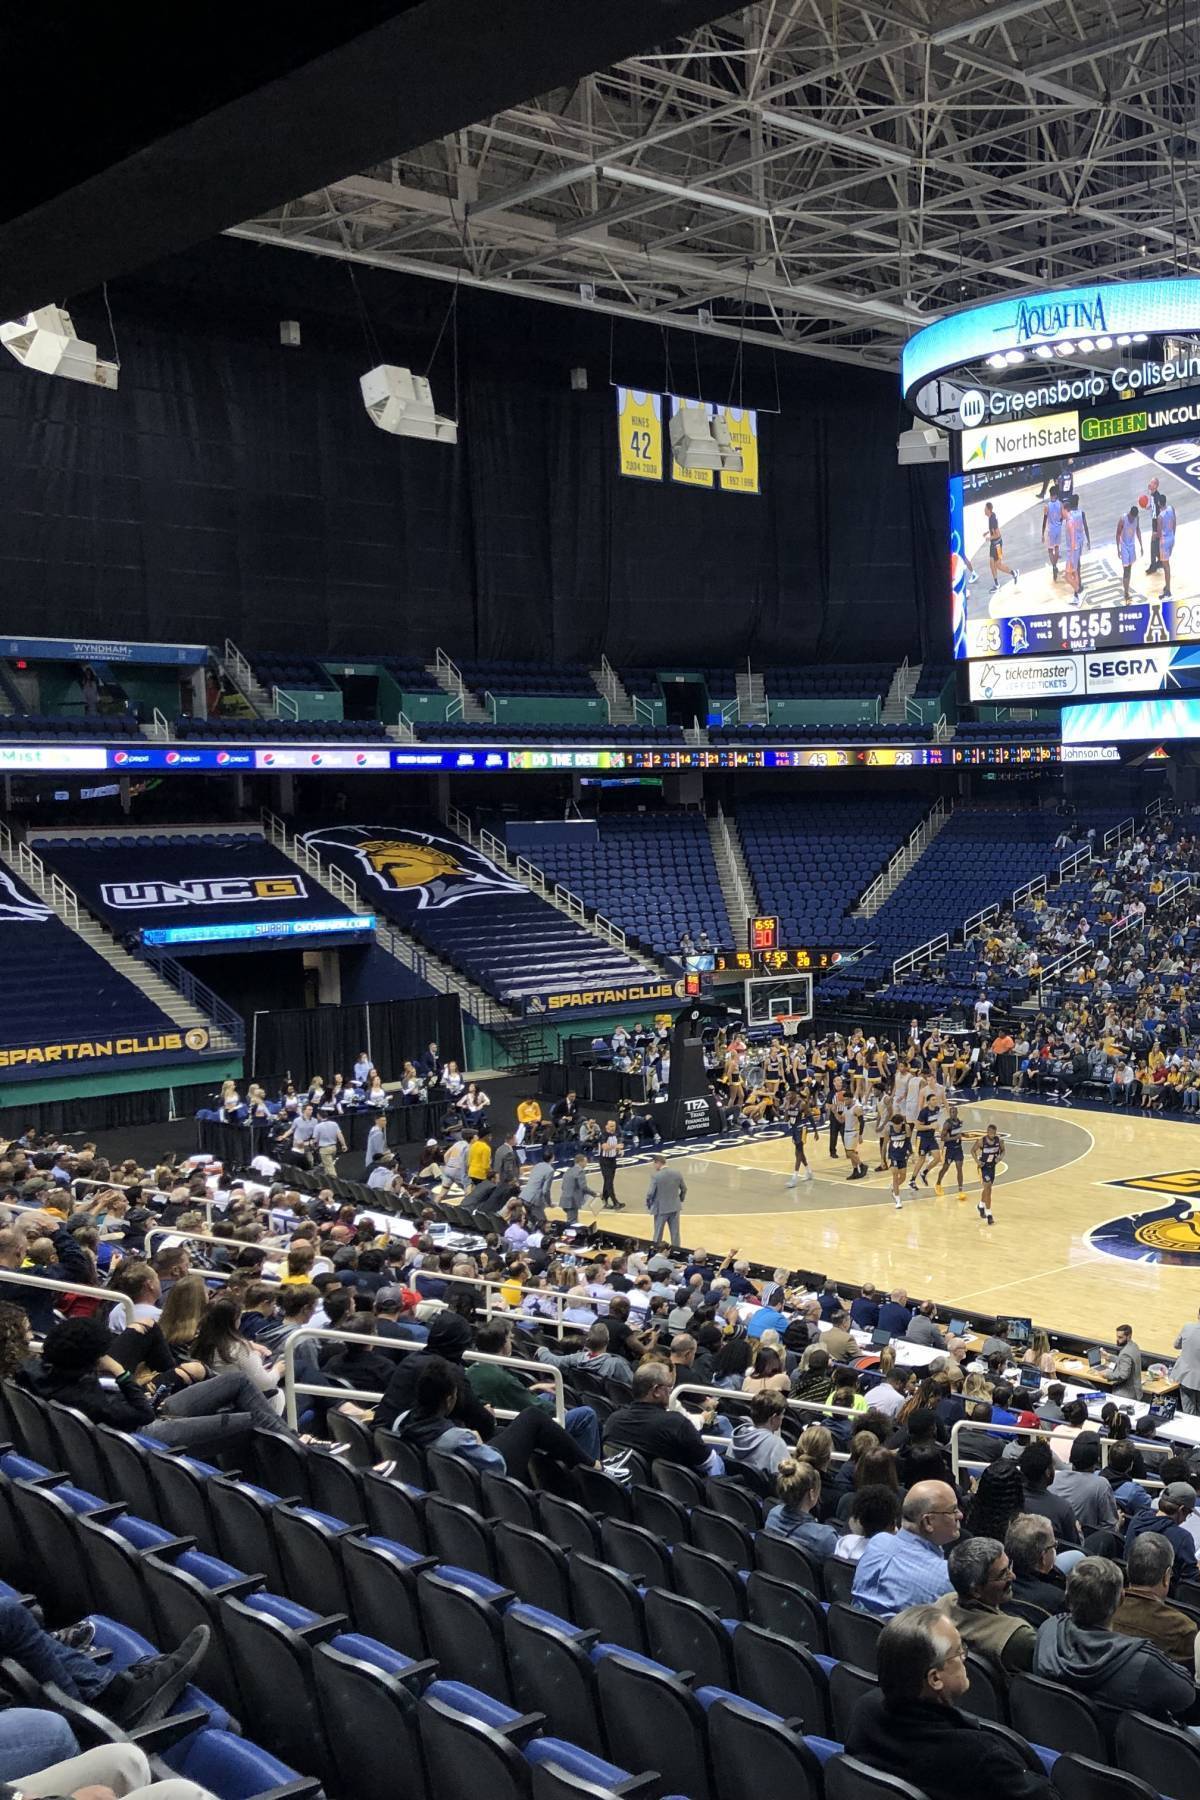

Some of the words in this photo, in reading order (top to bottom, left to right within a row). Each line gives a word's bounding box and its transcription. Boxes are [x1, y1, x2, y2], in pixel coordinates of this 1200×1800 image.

[1014, 294, 1107, 343] AQUAFINA
[989, 371, 1105, 416] Greensboro
[1082, 412, 1146, 441] GREEN
[631, 431, 652, 459] 42
[995, 426, 1077, 454] NorthState
[1058, 612, 1112, 640] 15:55
[976, 624, 1001, 651] 43
[73, 643, 127, 654] WYNDHAM
[1005, 665, 1070, 681] ticketmaster
[1089, 659, 1158, 678] SEGRA
[1039, 680, 1067, 689] TICKETS
[128, 755, 149, 763] pepsi
[180, 755, 200, 763] pepsi
[229, 755, 249, 763] pepsi
[532, 754, 547, 766] DO
[551, 754, 572, 766] THE
[808, 753, 827, 766] 43
[896, 753, 912, 766] 28
[1064, 748, 1099, 759] Johnson
[111, 879, 298, 904] UNCG
[255, 923, 290, 935] SWARM
[755, 920, 775, 929] 15:55
[755, 930, 773, 947] 30
[738, 960, 752, 968] 43
[798, 957, 809, 966] 28
[821, 957, 827, 966] 2
[548, 989, 627, 1009] SPARTAN
[629, 984, 673, 1000] CLUB
[0, 1041, 112, 1067] SPARTAN
[116, 1034, 182, 1055] CLUB
[684, 1099, 709, 1111] TFA
